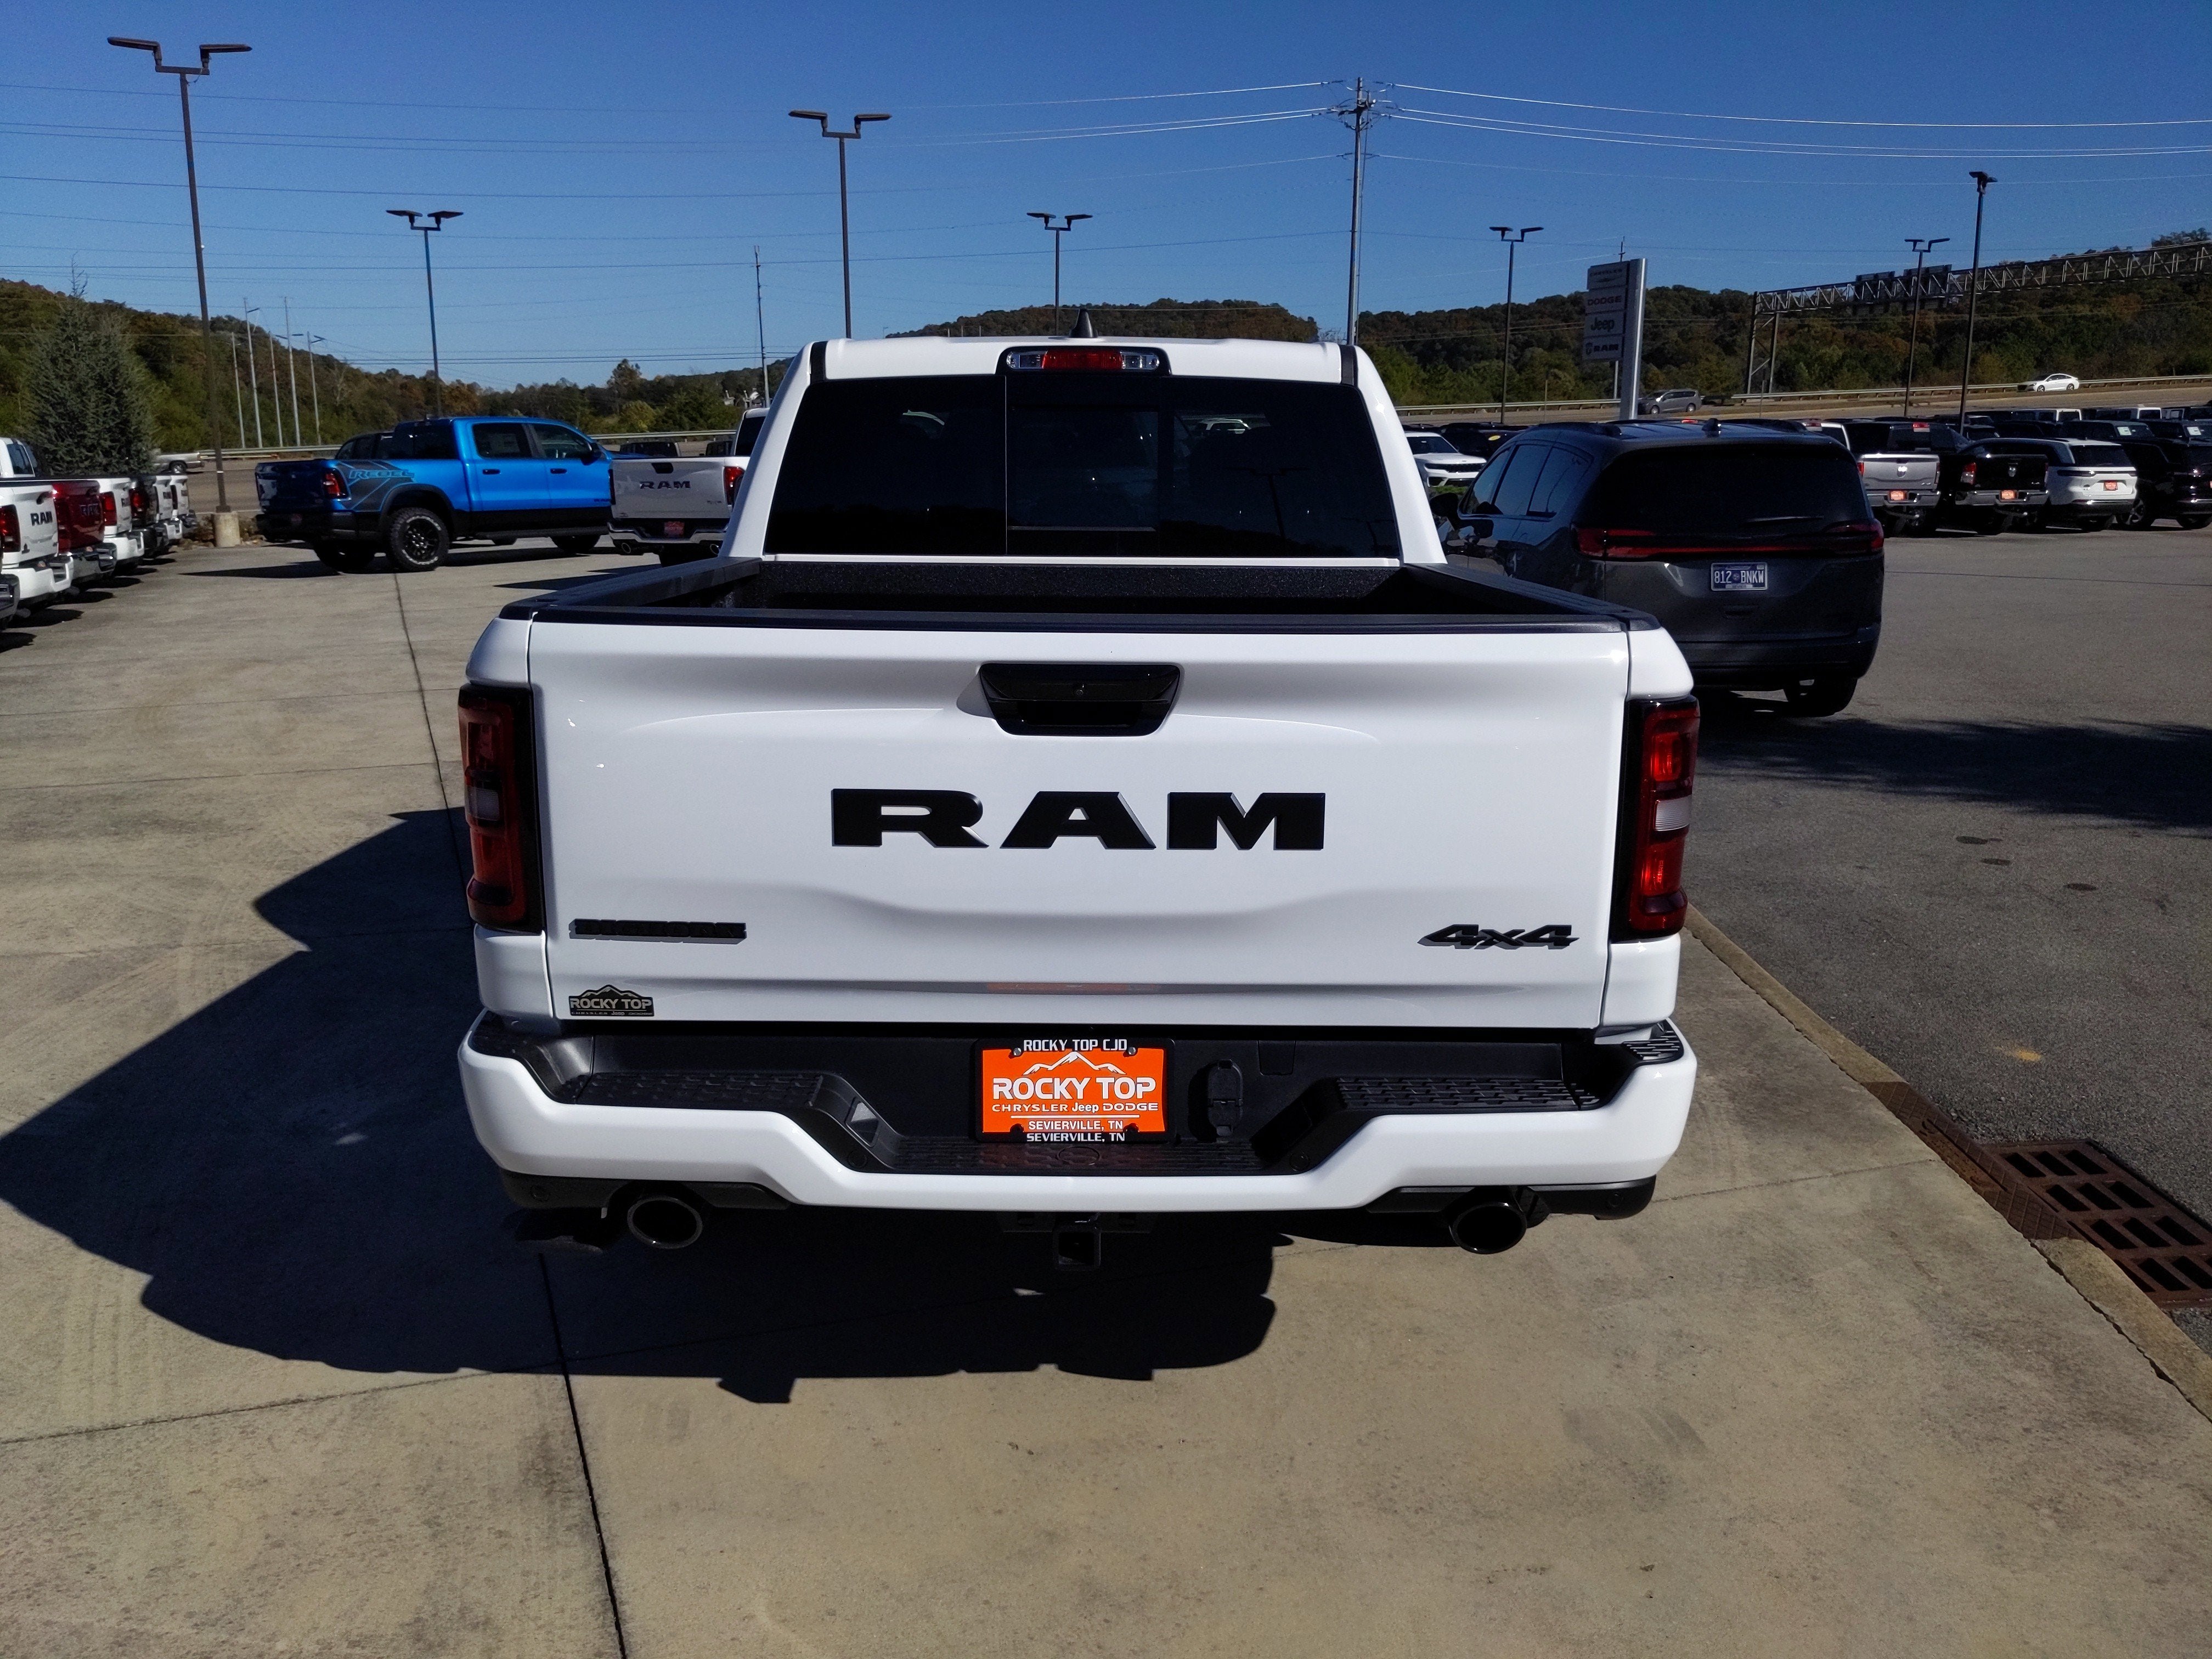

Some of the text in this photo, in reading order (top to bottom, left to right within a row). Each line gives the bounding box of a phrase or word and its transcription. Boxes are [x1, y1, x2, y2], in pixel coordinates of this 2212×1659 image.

[1588, 295, 1622, 306] DODGE
[1590, 317, 1615, 332] Jeep
[1594, 343, 1618, 352] RAM
[640, 481, 691, 489] RAM
[30, 511, 53, 527] RAM
[1714, 571, 1764, 583] 812 BNKW
[832, 788, 1325, 850] RAM
[1417, 924, 1580, 950] 4x4
[569, 998, 652, 1009] ROCKY TOP
[1024, 1039, 1127, 1051] ROCKY TOP CJD
[993, 1077, 1156, 1099] ROCKY TOP
[992, 1102, 1158, 1113] CHRYSLER Jeep DODGE
[1028, 1120, 1123, 1131] SEVIERVILLE, TN
[1026, 1132, 1125, 1142] SEVIERVILLE, TN
